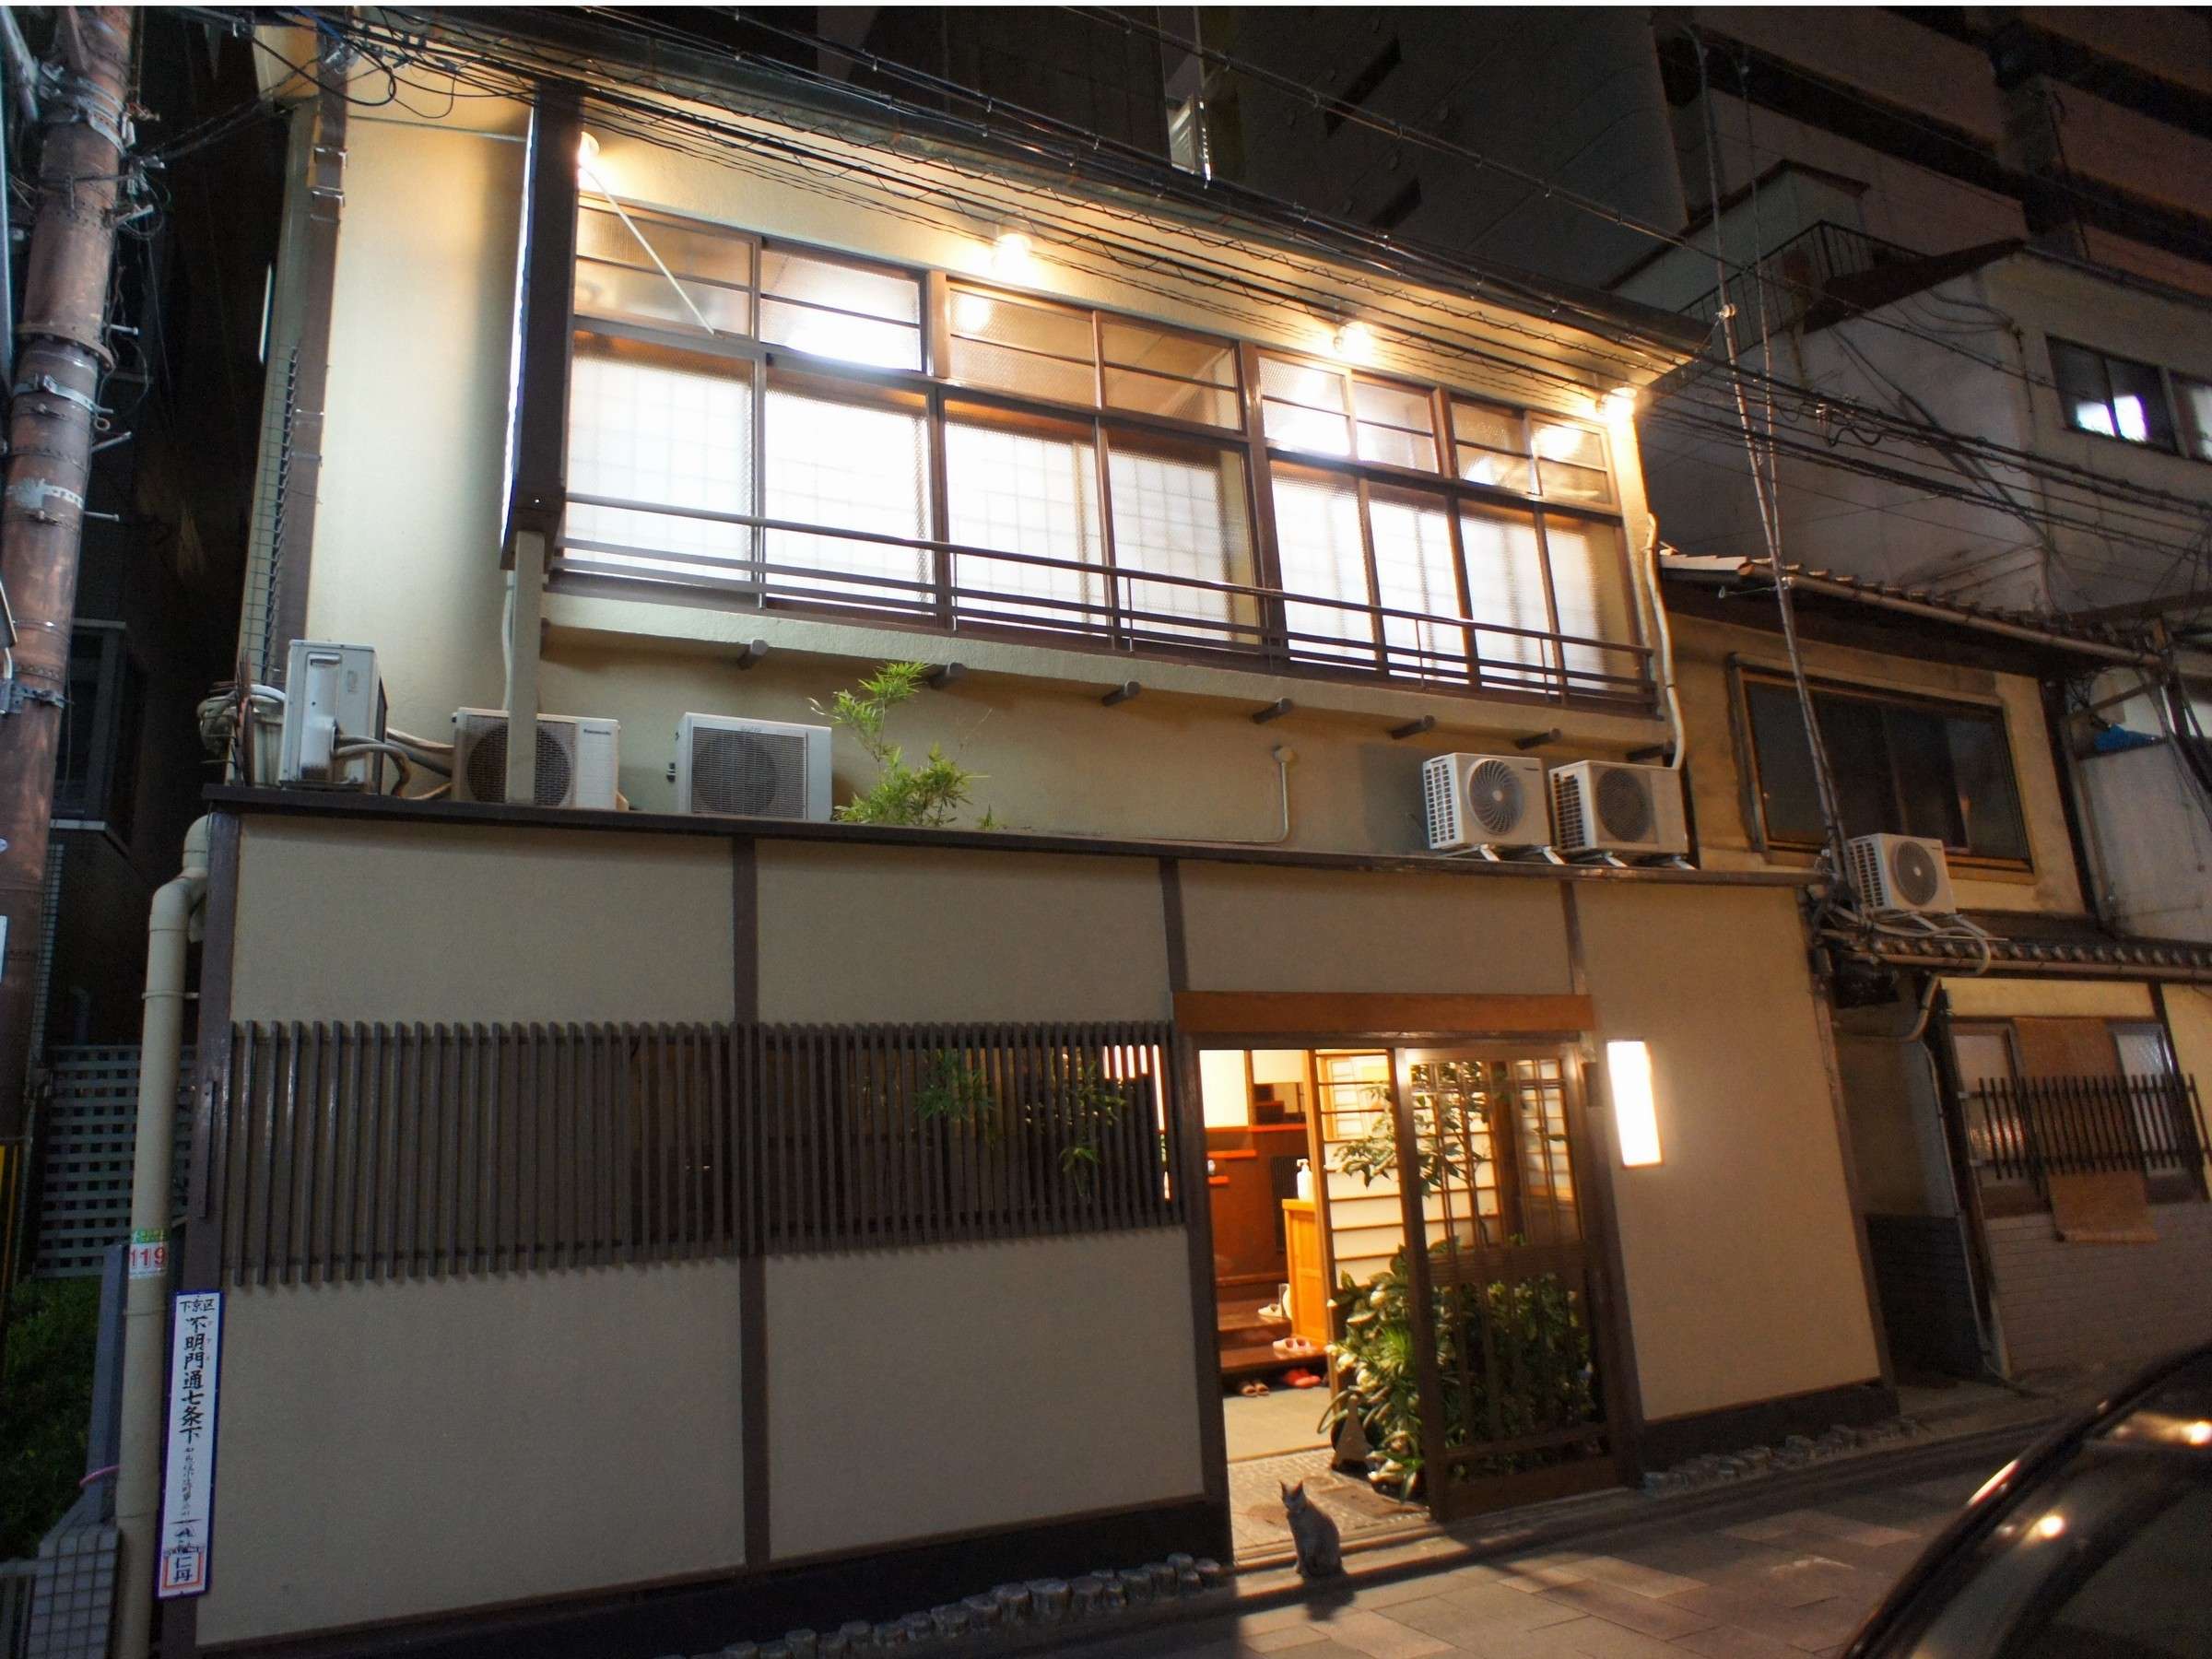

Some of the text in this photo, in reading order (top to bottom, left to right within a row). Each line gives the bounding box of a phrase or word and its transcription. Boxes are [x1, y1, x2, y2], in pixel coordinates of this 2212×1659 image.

[130, 1247, 166, 1267] 119
[180, 1298, 216, 1312] 下京区
